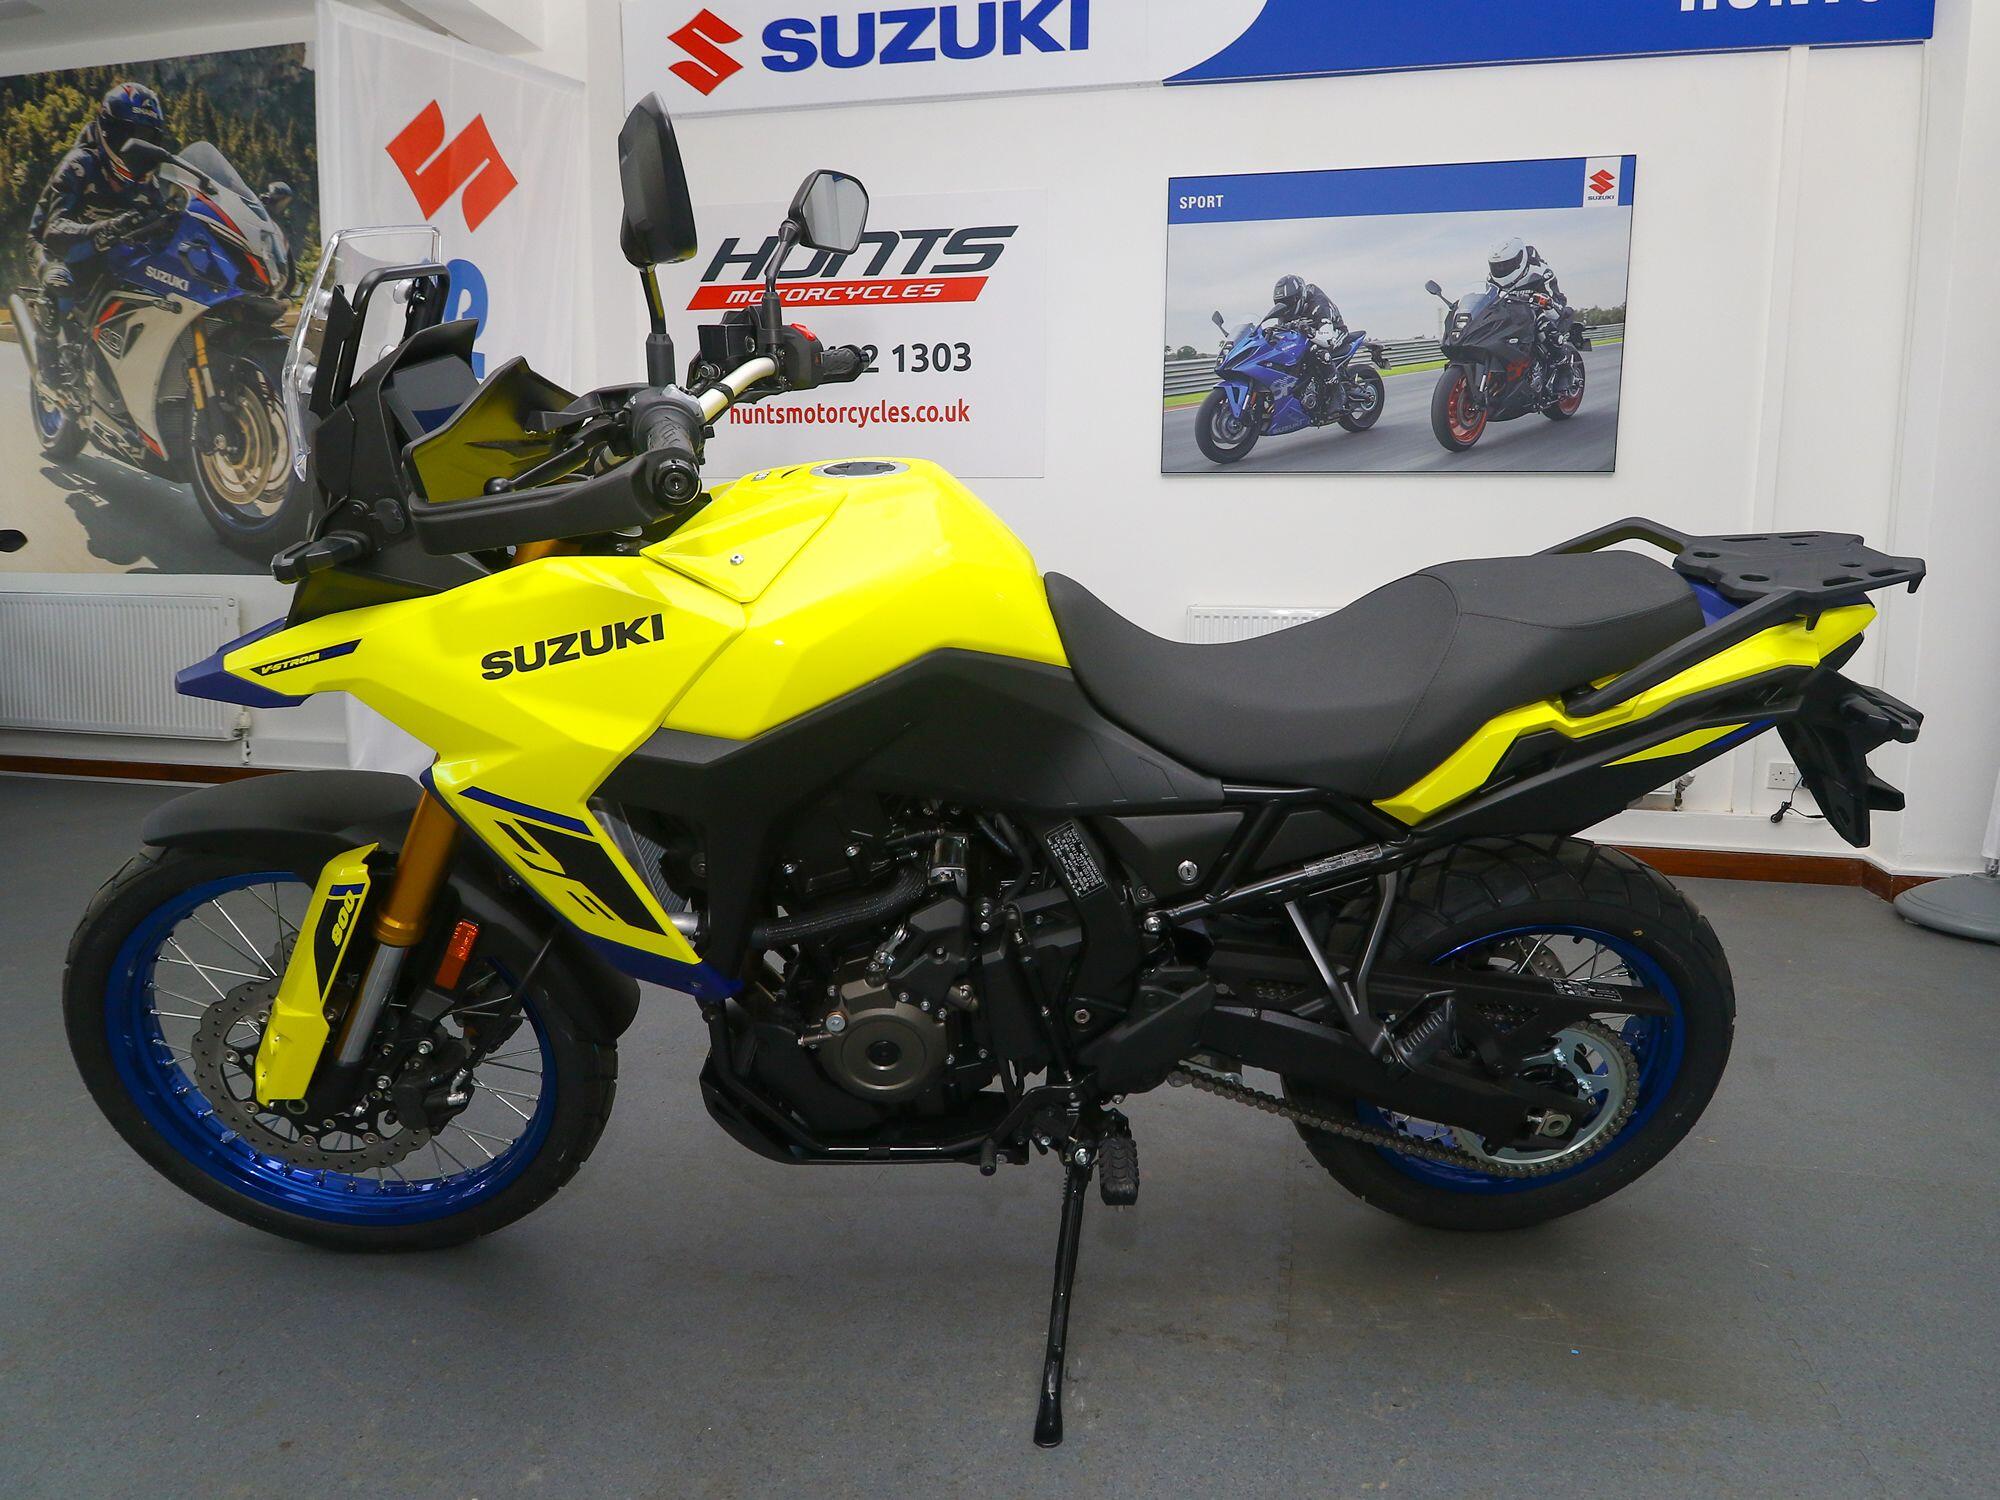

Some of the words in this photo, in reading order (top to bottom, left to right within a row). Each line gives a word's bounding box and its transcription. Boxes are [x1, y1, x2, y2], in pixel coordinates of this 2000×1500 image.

[761, 0, 1089, 72] SUZUKI
[1179, 194, 1224, 209] SPORT
[144, 265, 189, 292] SUZUKI
[892, 342, 972, 373] 1303
[729, 399, 970, 428] huntsmotorcycles.co.uk
[481, 613, 665, 681] SUZUKI
[261, 653, 320, 675] V-STROM
[331, 889, 355, 947] 800
